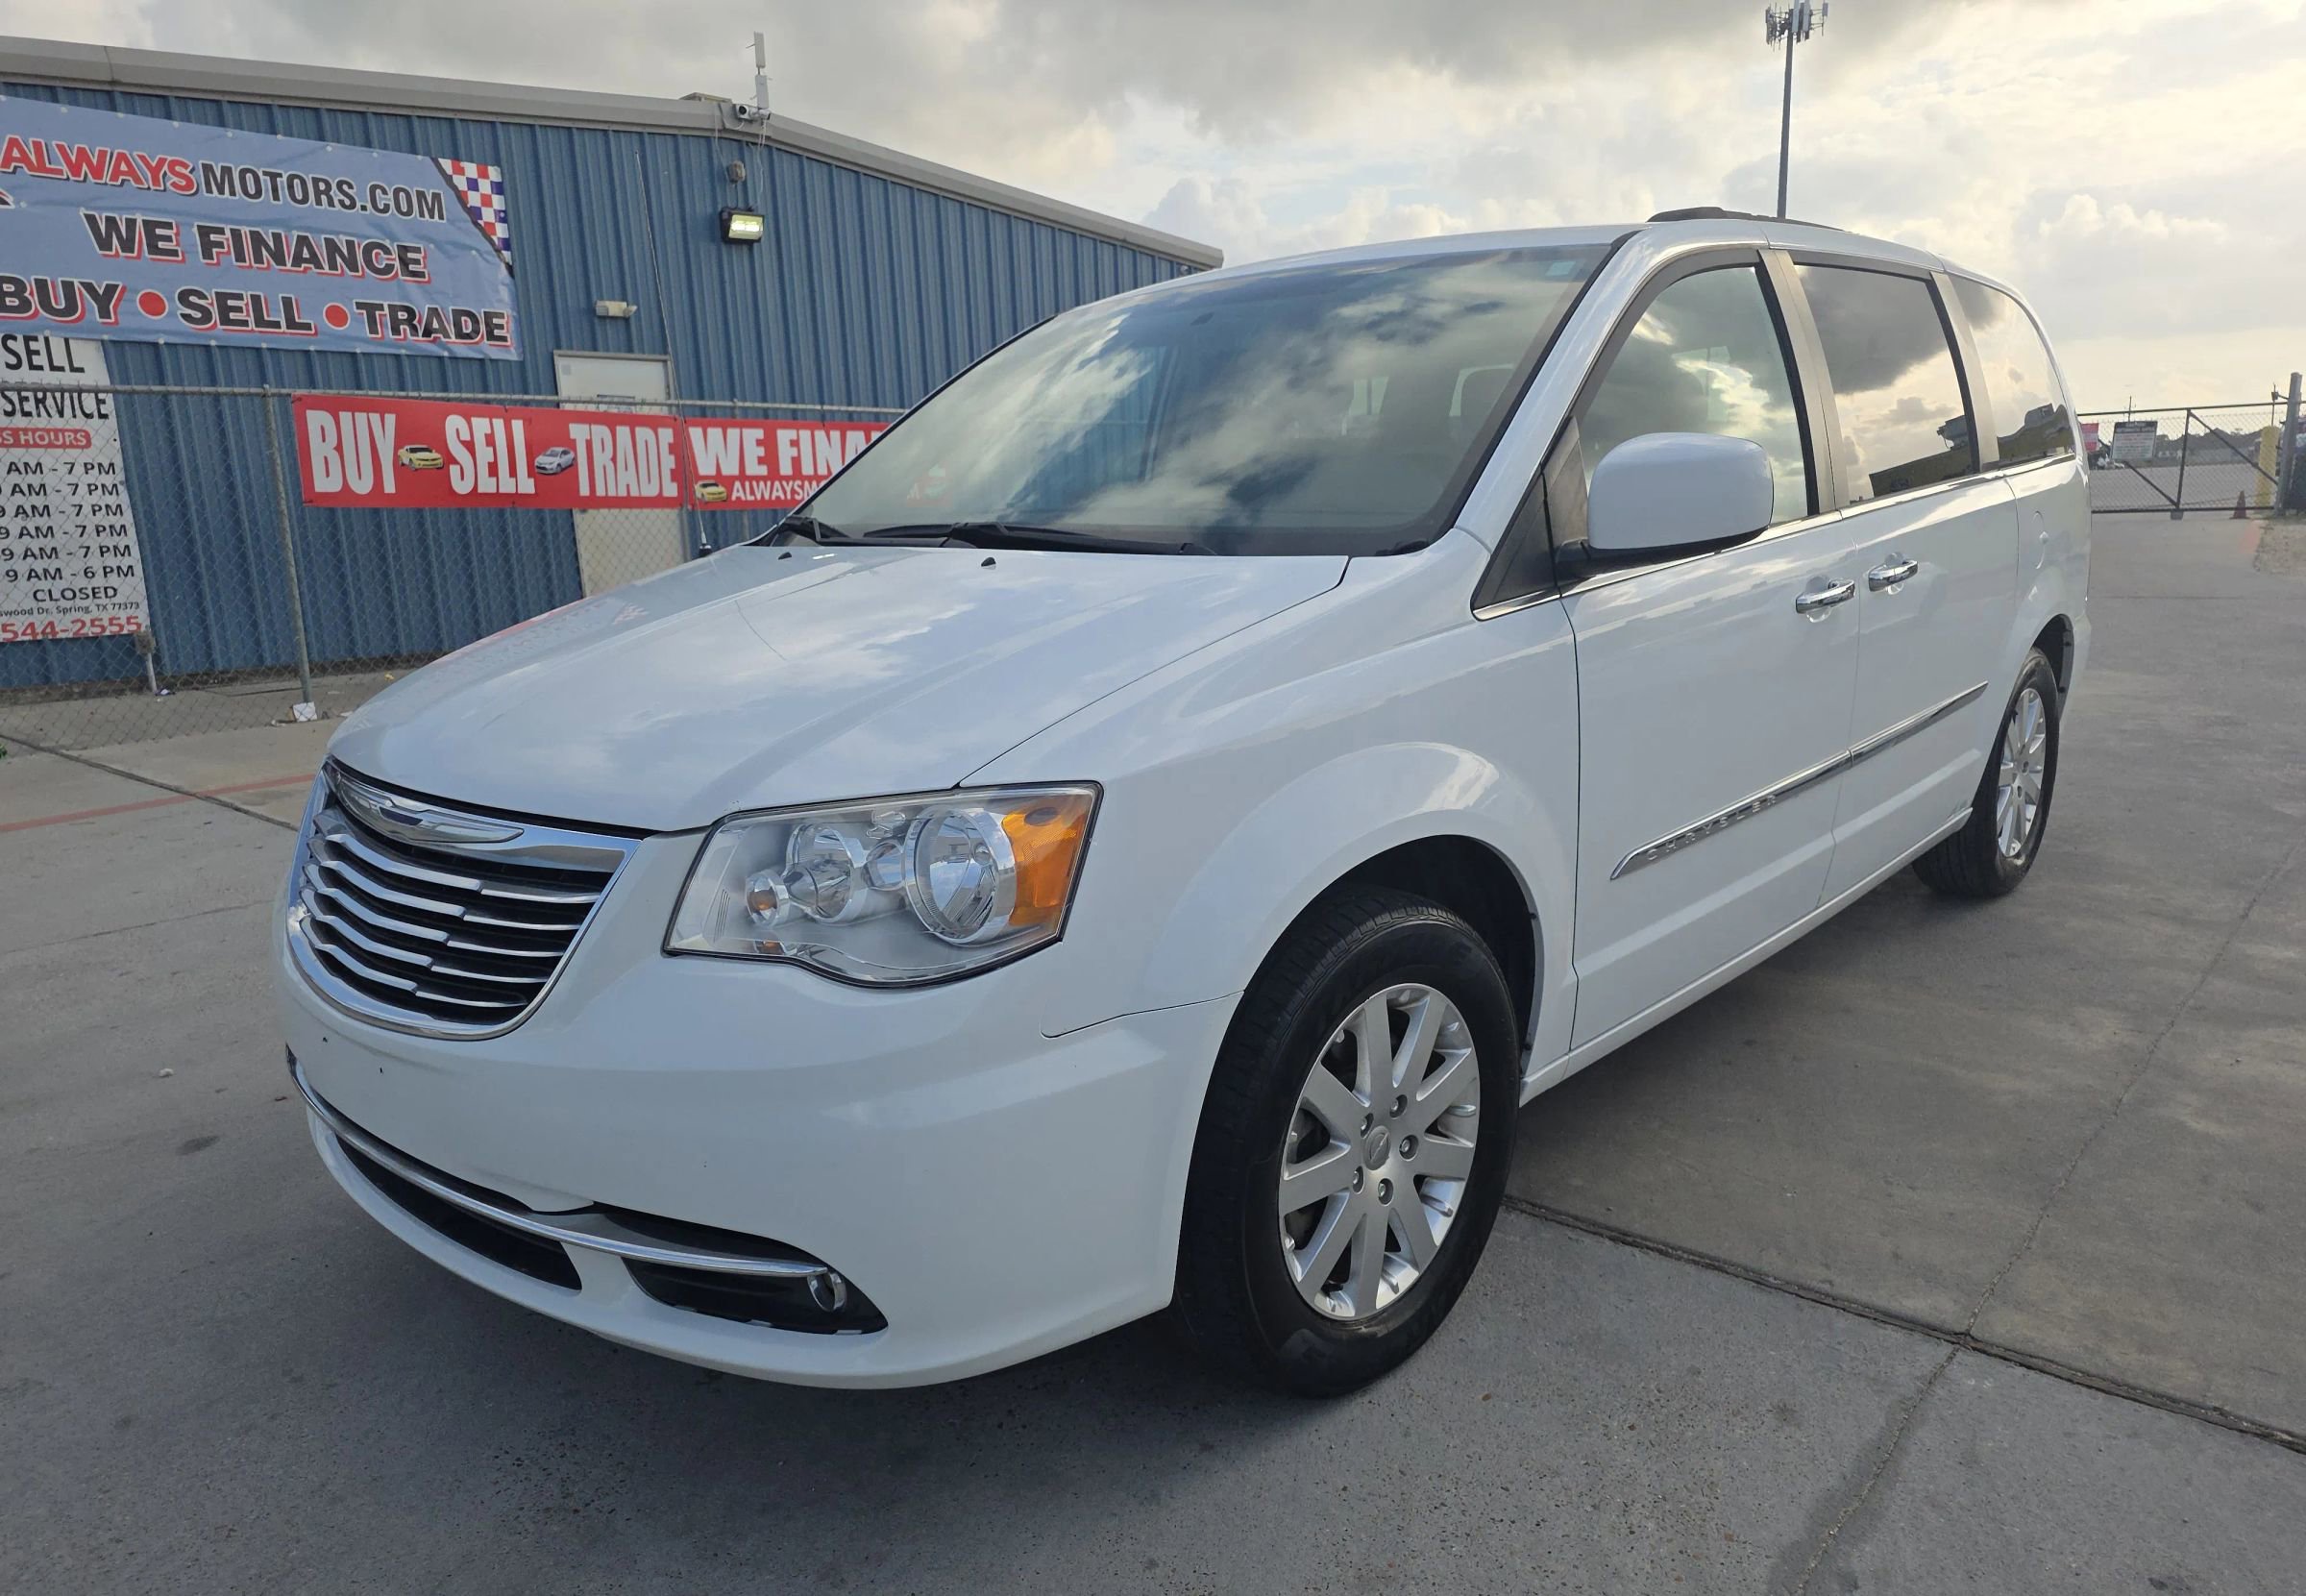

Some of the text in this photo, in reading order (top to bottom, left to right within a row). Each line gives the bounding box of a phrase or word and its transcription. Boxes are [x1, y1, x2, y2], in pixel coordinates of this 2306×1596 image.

[81, 209, 429, 283] WE FINANCE
[0, 273, 511, 346] BUY SELL TRADE
[1, 333, 85, 373] SELL
[1, 382, 109, 419] SERVICE
[19, 430, 86, 445] HOURS
[306, 409, 678, 498] BUY SELL TRADE
[688, 426, 881, 477] WE FINA
[7, 461, 43, 475] AM
[63, 461, 75, 475] 7
[84, 461, 115, 475] PM
[11, 482, 47, 497] AM
[67, 482, 79, 496] 7
[87, 482, 119, 496] PM
[731, 479, 824, 502] ALWAYSM
[14, 504, 51, 518] AM
[71, 503, 83, 517] 7
[91, 503, 123, 517] PM
[18, 526, 55, 539] AM
[75, 525, 86, 537] 7
[95, 524, 127, 537] PM
[1, 548, 14, 561] 9
[22, 546, 59, 560] AM
[79, 546, 90, 558] 7
[99, 544, 132, 557] PM
[5, 569, 18, 582] 9
[27, 567, 63, 581] AM
[84, 566, 96, 579] 6
[103, 564, 135, 578] PM
[33, 585, 117, 602] CLOSED
[96, 603, 108, 612] TX
[1, 615, 142, 642] 544-2555
[1646, 795, 1777, 861] CHRYSLER
